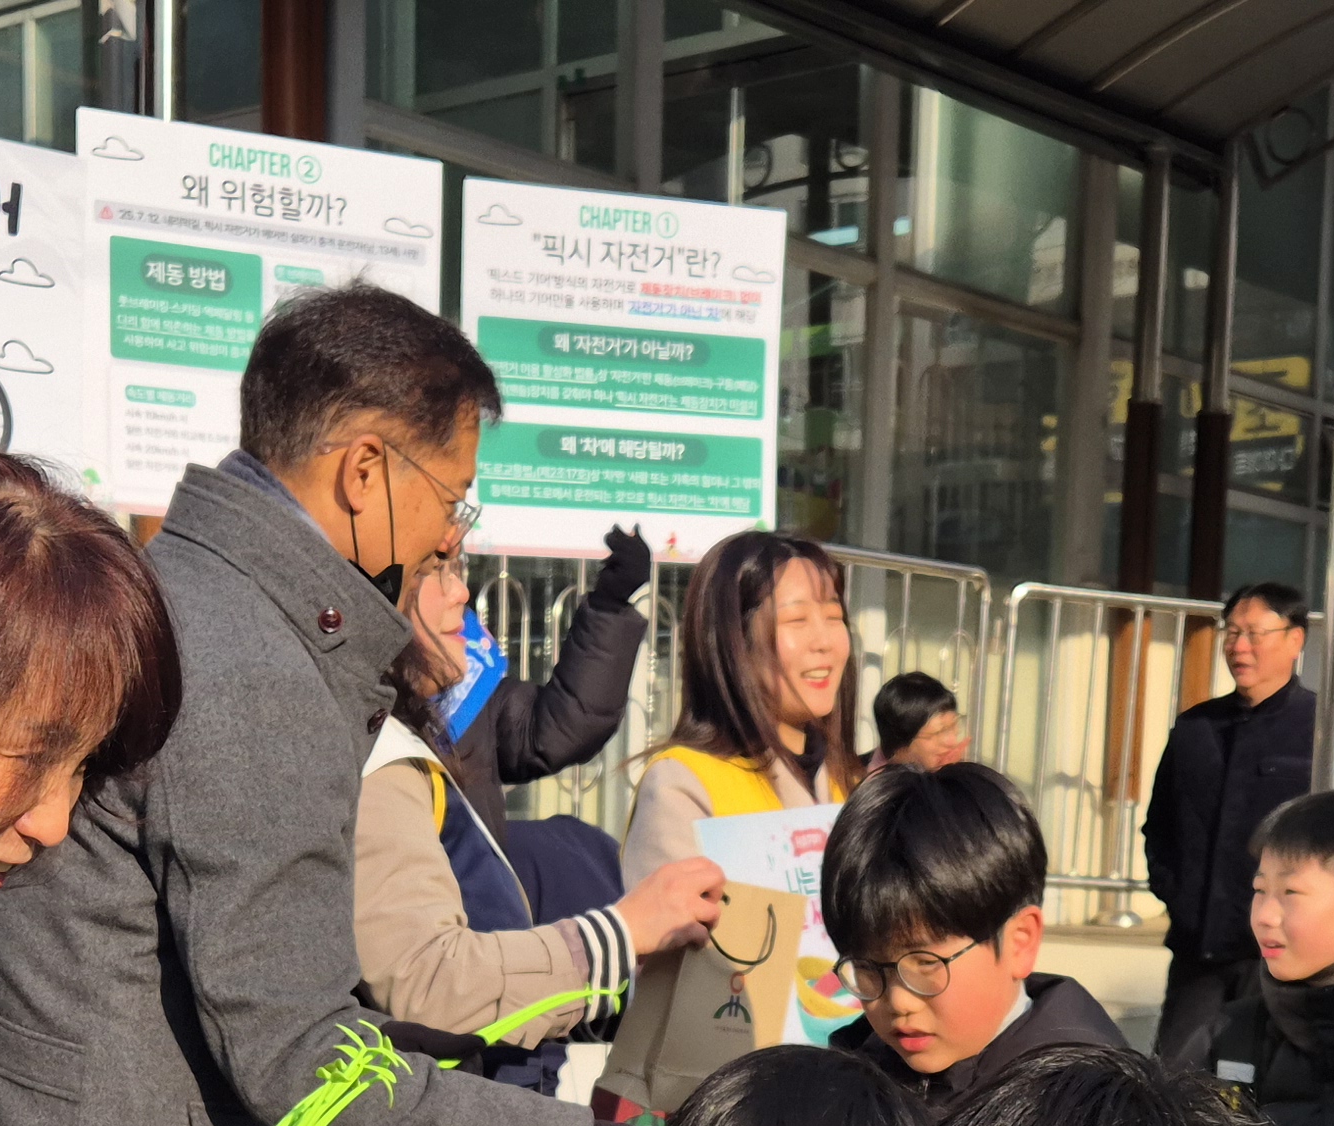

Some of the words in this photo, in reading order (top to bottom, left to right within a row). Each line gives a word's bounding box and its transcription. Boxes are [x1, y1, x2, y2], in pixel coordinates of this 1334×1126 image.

[209, 143, 291, 178] CHAPTER
[181, 174, 209, 208] 왜
[220, 178, 348, 226] 위험할까?
[579, 205, 651, 234] CHAPTER
[533, 233, 591, 268] "픽시
[599, 240, 722, 279] 자전거"란?
[145, 261, 184, 286] 제동
[188, 265, 226, 292] 방법
[554, 332, 570, 352] 왜
[641, 340, 695, 361] 아닐까?
[560, 436, 577, 455] 왜
